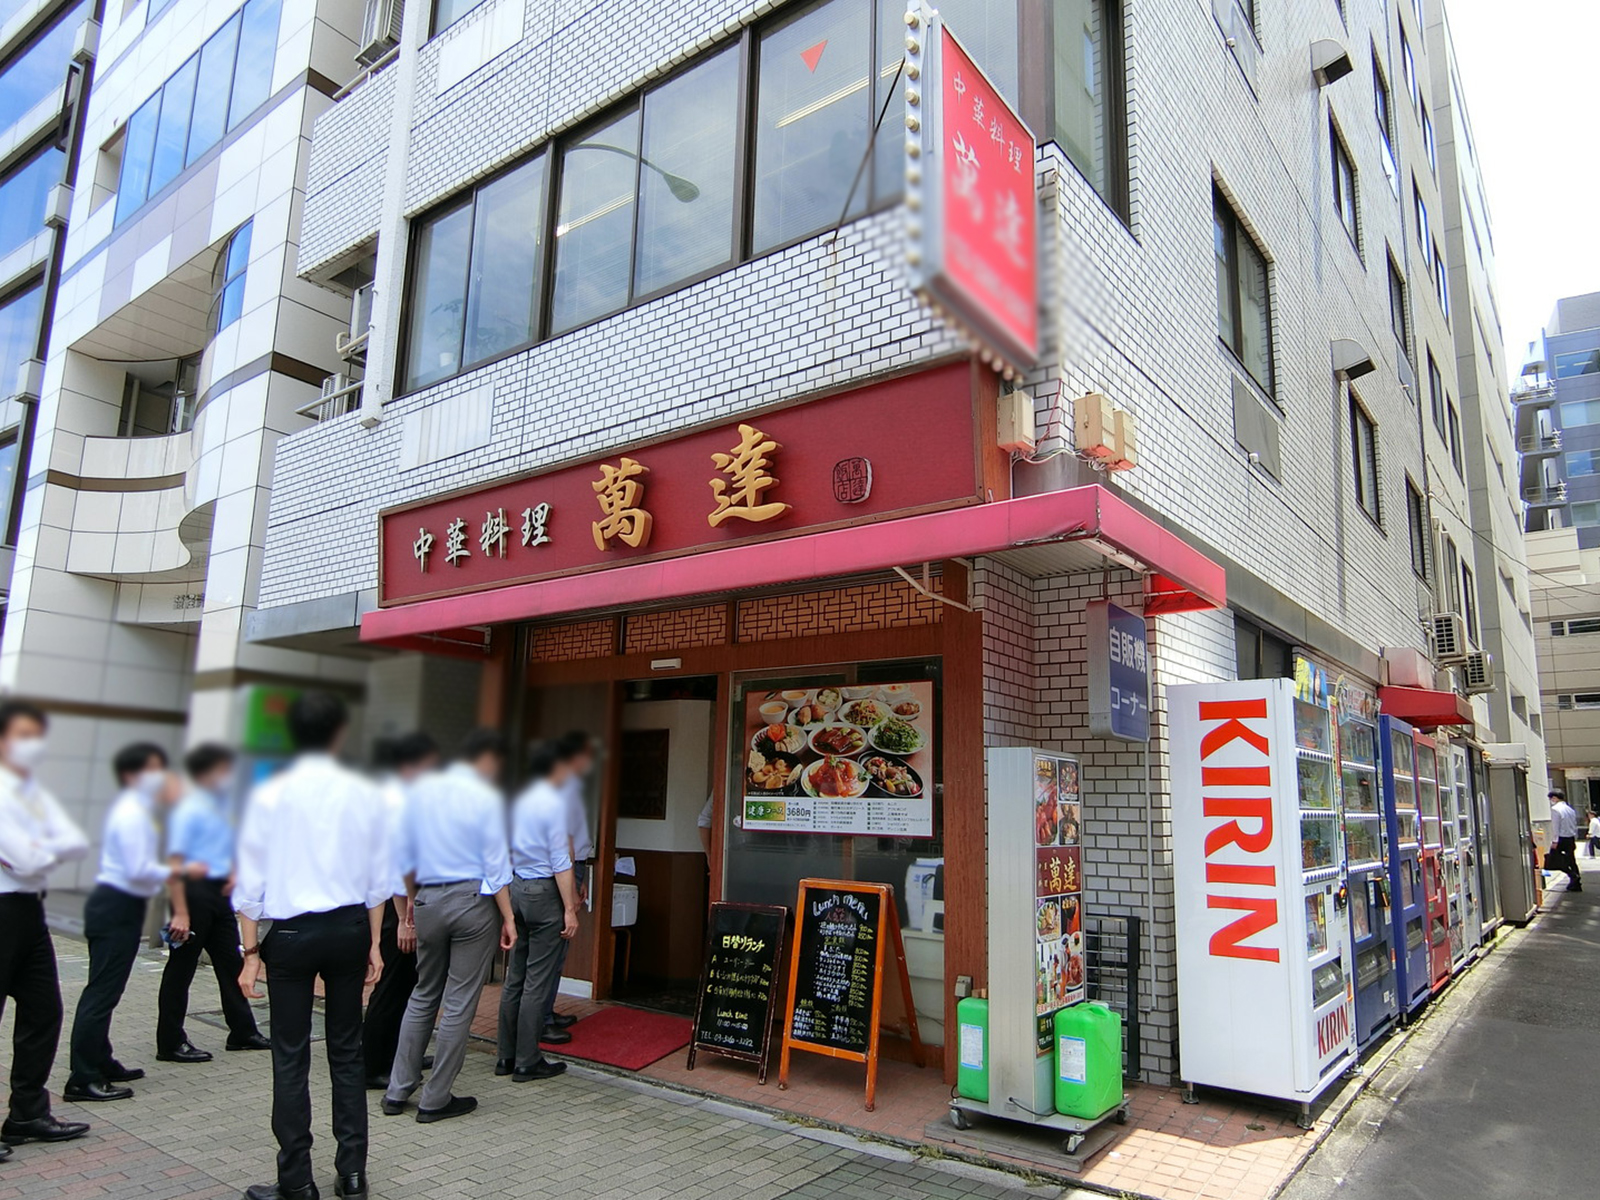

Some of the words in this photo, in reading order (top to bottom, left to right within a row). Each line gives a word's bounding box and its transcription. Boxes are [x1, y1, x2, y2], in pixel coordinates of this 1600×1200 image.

[952, 71, 1024, 175] 中華料理
[591, 423, 793, 552] 萬達
[412, 502, 553, 573] 中華料理
[1109, 626, 1146, 674] 自販機
[1111, 687, 1147, 716] コーナー
[787, 807, 811, 817] 3680円
[1199, 698, 1280, 963] KIRIN
[1049, 856, 1077, 892] 萬達
[813, 894, 840, 917] Lunch
[722, 935, 766, 953] 日替りランチ
[706, 984, 713, 993] C
[1317, 1002, 1349, 1060] KIRIN
